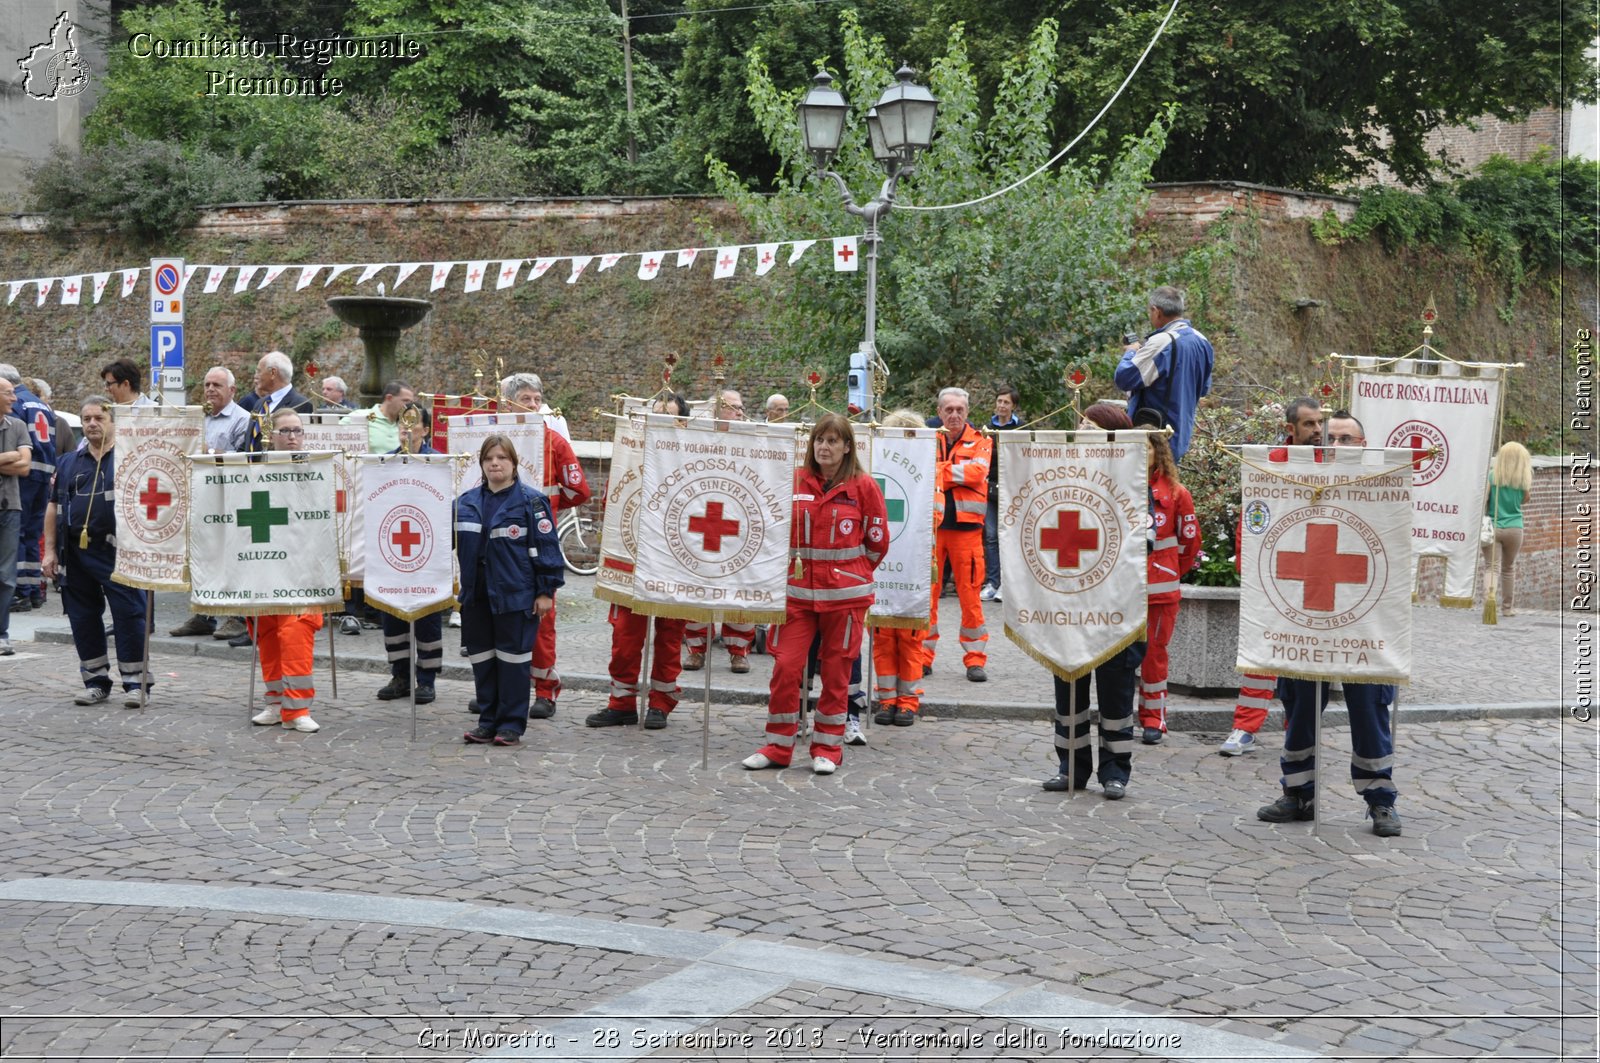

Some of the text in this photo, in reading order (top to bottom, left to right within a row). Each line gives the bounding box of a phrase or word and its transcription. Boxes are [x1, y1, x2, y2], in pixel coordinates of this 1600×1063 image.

[158, 330, 176, 362] P
[1358, 381, 1489, 405] CROCE ROSSA ITALIANA
[656, 440, 680, 452] CORPO
[684, 443, 727, 455] VOLONTARI
[731, 447, 746, 457] DEL
[750, 450, 787, 461] SOCCORSO
[1066, 448, 1080, 458] DEL
[1085, 448, 1125, 458] SOCCORSO
[883, 448, 923, 483] VERDE
[257, 472, 324, 483] ASSISTENZA
[611, 470, 637, 503] CROCE
[1249, 472, 1278, 485] CORPO
[1334, 475, 1350, 486] DEL
[1355, 476, 1403, 487] SOCCORSO
[368, 479, 398, 502] VOLONTARI
[411, 479, 444, 502] SOCCORSO
[647, 458, 784, 523] CROCE ROSSA ITALIANA
[1004, 466, 1141, 530] CROCE ROSSA ITALIANA
[1244, 486, 1288, 499] CROCE
[1348, 489, 1410, 502] ITALIANA
[295, 510, 331, 520] VERDE
[1417, 501, 1459, 514] LOCALE
[668, 480, 761, 573] CONVENZIONE DI GINEVRA 22 AGOSTO 1864
[1264, 508, 1326, 549] CONVENZIONE
[1332, 508, 1344, 518] DI
[1347, 516, 1382, 555] GINEVRA
[1432, 531, 1465, 541] BOSCO
[1024, 489, 1118, 588] CONVENZIONE DI GINEVRA 22 AGOSTO 1864
[238, 551, 287, 561] SALUZZO
[879, 562, 903, 572] OLO
[194, 590, 252, 599] VOLONTARI
[273, 588, 335, 598] SOCCORSO
[645, 580, 773, 602] GRUPPO DI ALBA
[873, 581, 921, 591] SSISTENZA
[1018, 609, 1124, 626] SAVIGLIANO
[1264, 631, 1319, 645] COMITATO
[1334, 638, 1385, 650] LOCALE
[1273, 645, 1368, 665] MORETTA
